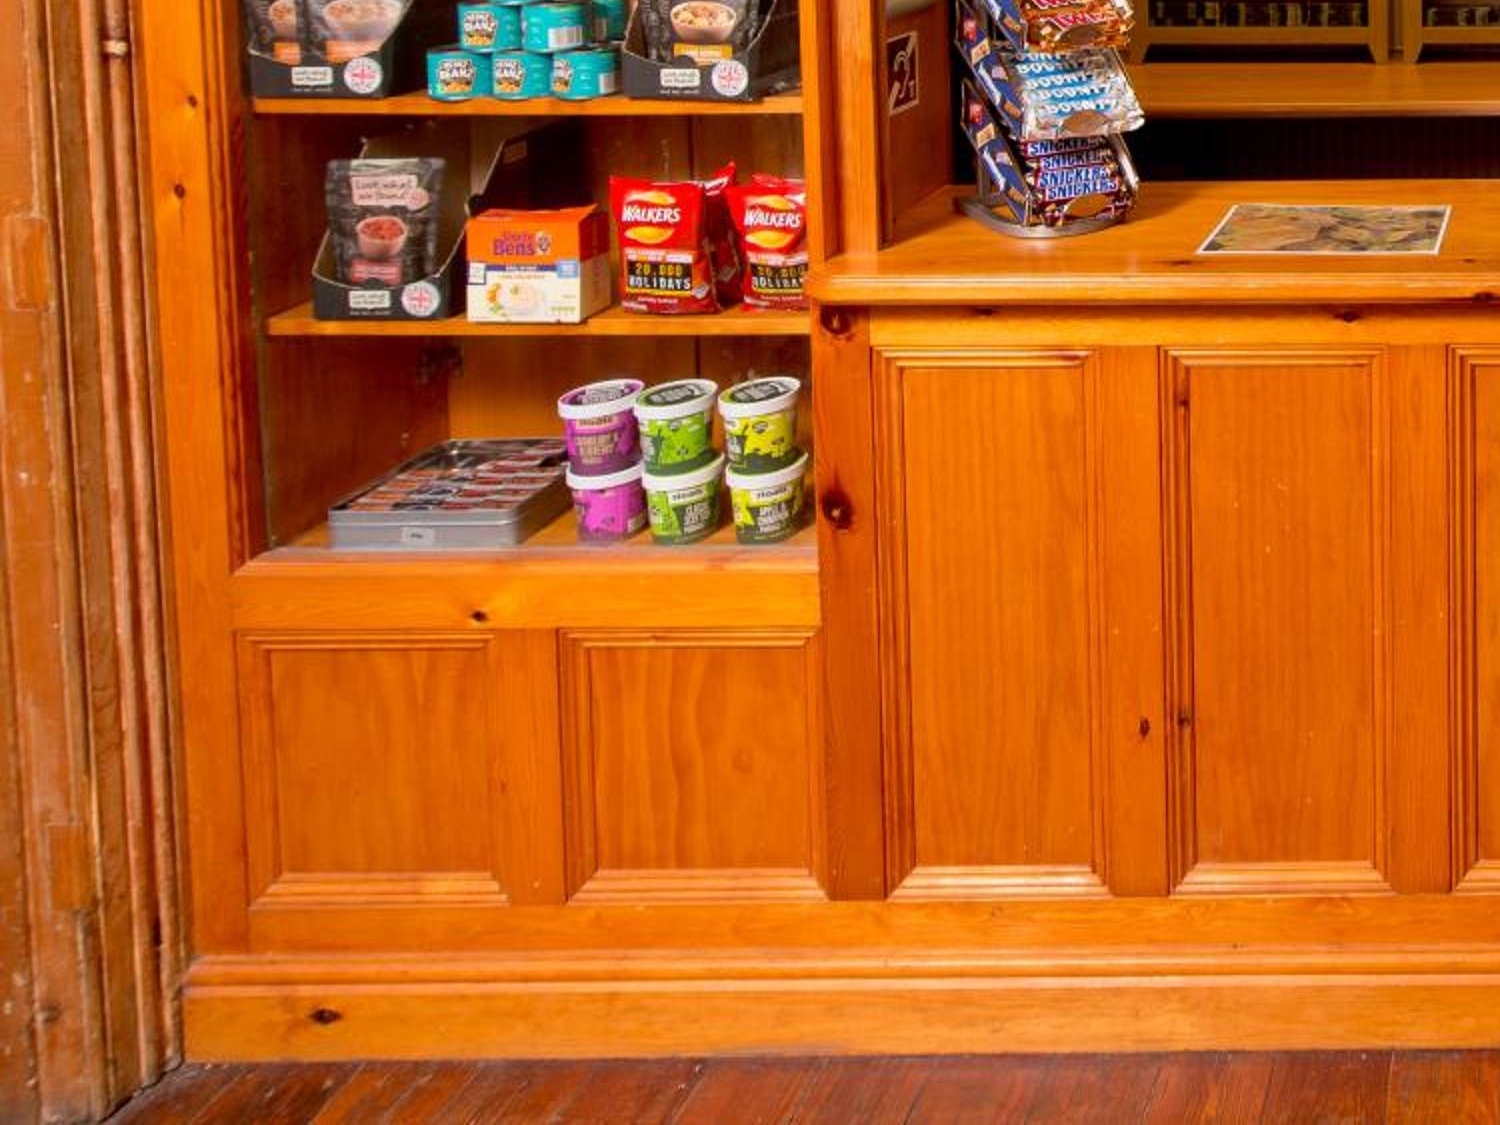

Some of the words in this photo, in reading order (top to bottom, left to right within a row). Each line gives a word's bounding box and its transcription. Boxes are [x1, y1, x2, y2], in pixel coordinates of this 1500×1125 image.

[1040, 165, 1108, 188] SNICKERS
[1047, 179, 1117, 200] SNICKERS
[621, 205, 681, 222] WALKERS
[744, 209, 801, 228] WALKERS
[629, 276, 691, 291] HOLIDAYS
